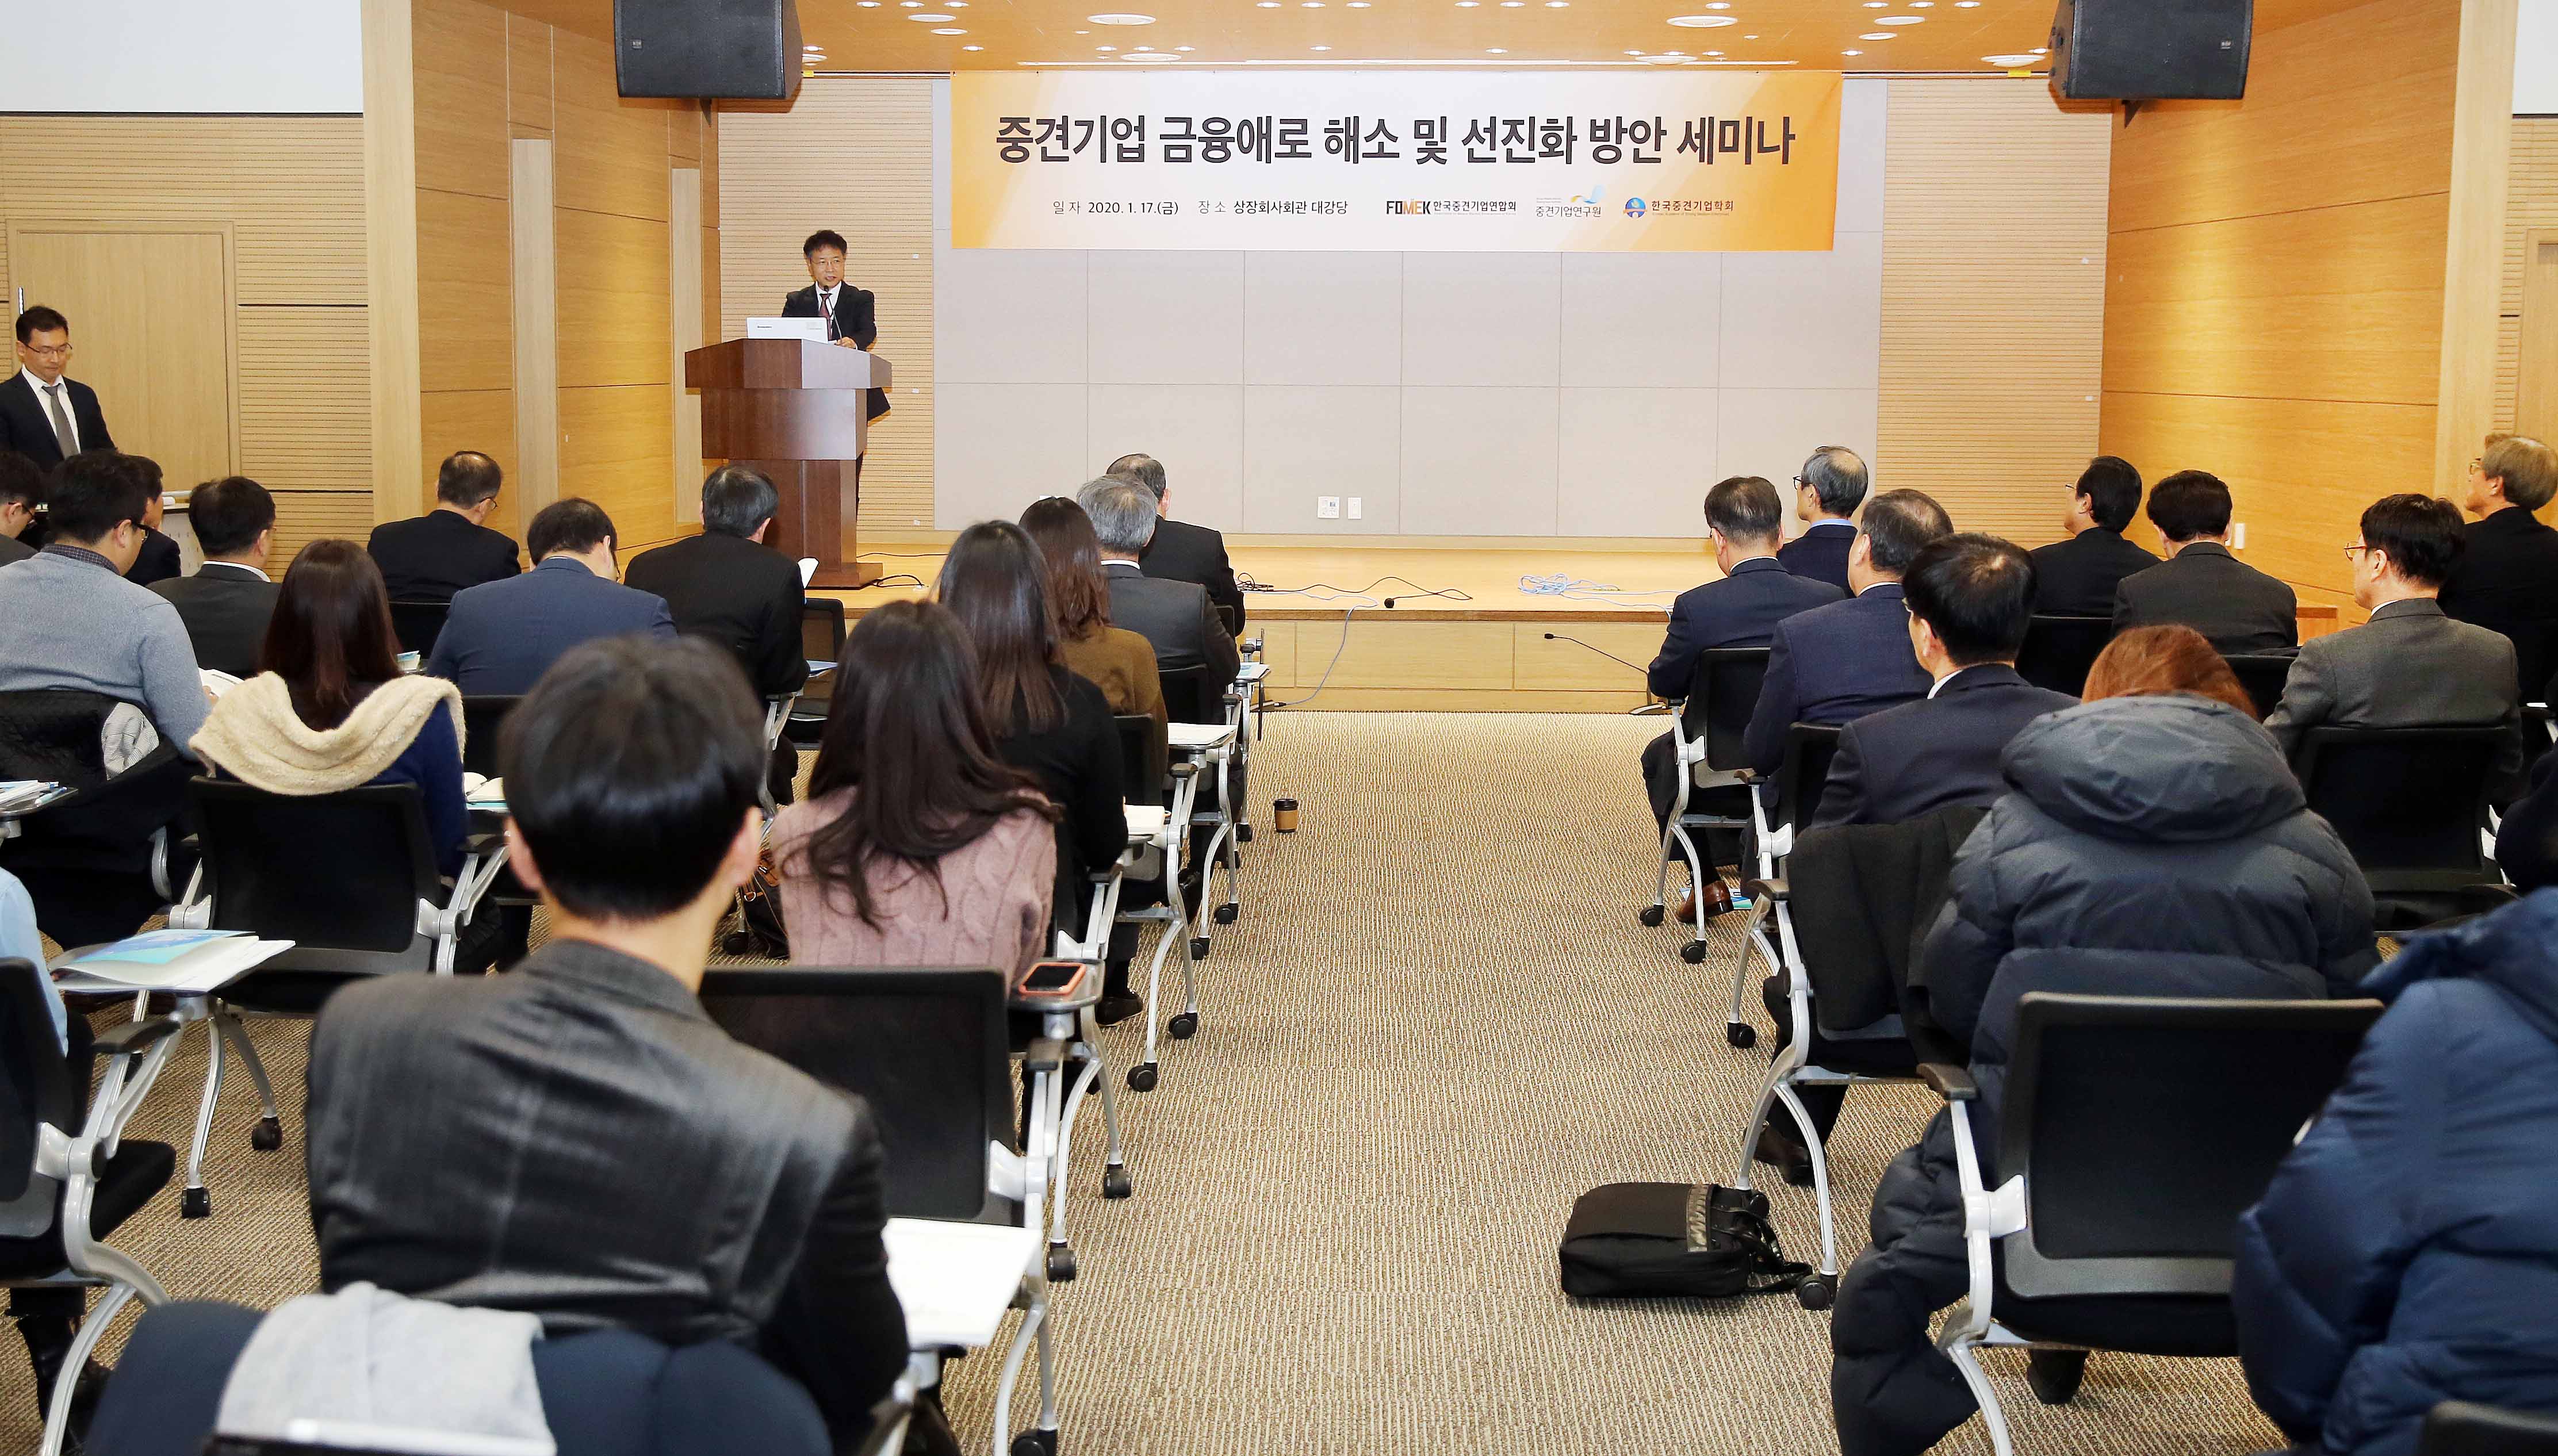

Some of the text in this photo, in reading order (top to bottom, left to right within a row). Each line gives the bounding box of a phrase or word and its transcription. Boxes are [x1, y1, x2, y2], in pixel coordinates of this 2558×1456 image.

[996, 115, 1796, 165] 중견기업 금융애로 해소 및 선진화 방안 세미나
[1088, 202, 1124, 213] 2020.
[1128, 202, 1136, 213] 1.
[1141, 201, 1178, 215] 17.(금)
[1234, 200, 1307, 214] 상장회사회관
[1311, 200, 1348, 215] 대강당
[1386, 200, 1431, 214] FOMEK
[1434, 201, 1517, 212] 한국중견기업연합회
[1536, 206, 1601, 217] 중견기업연구원
[1652, 200, 1733, 212] 한국중견기업학회
